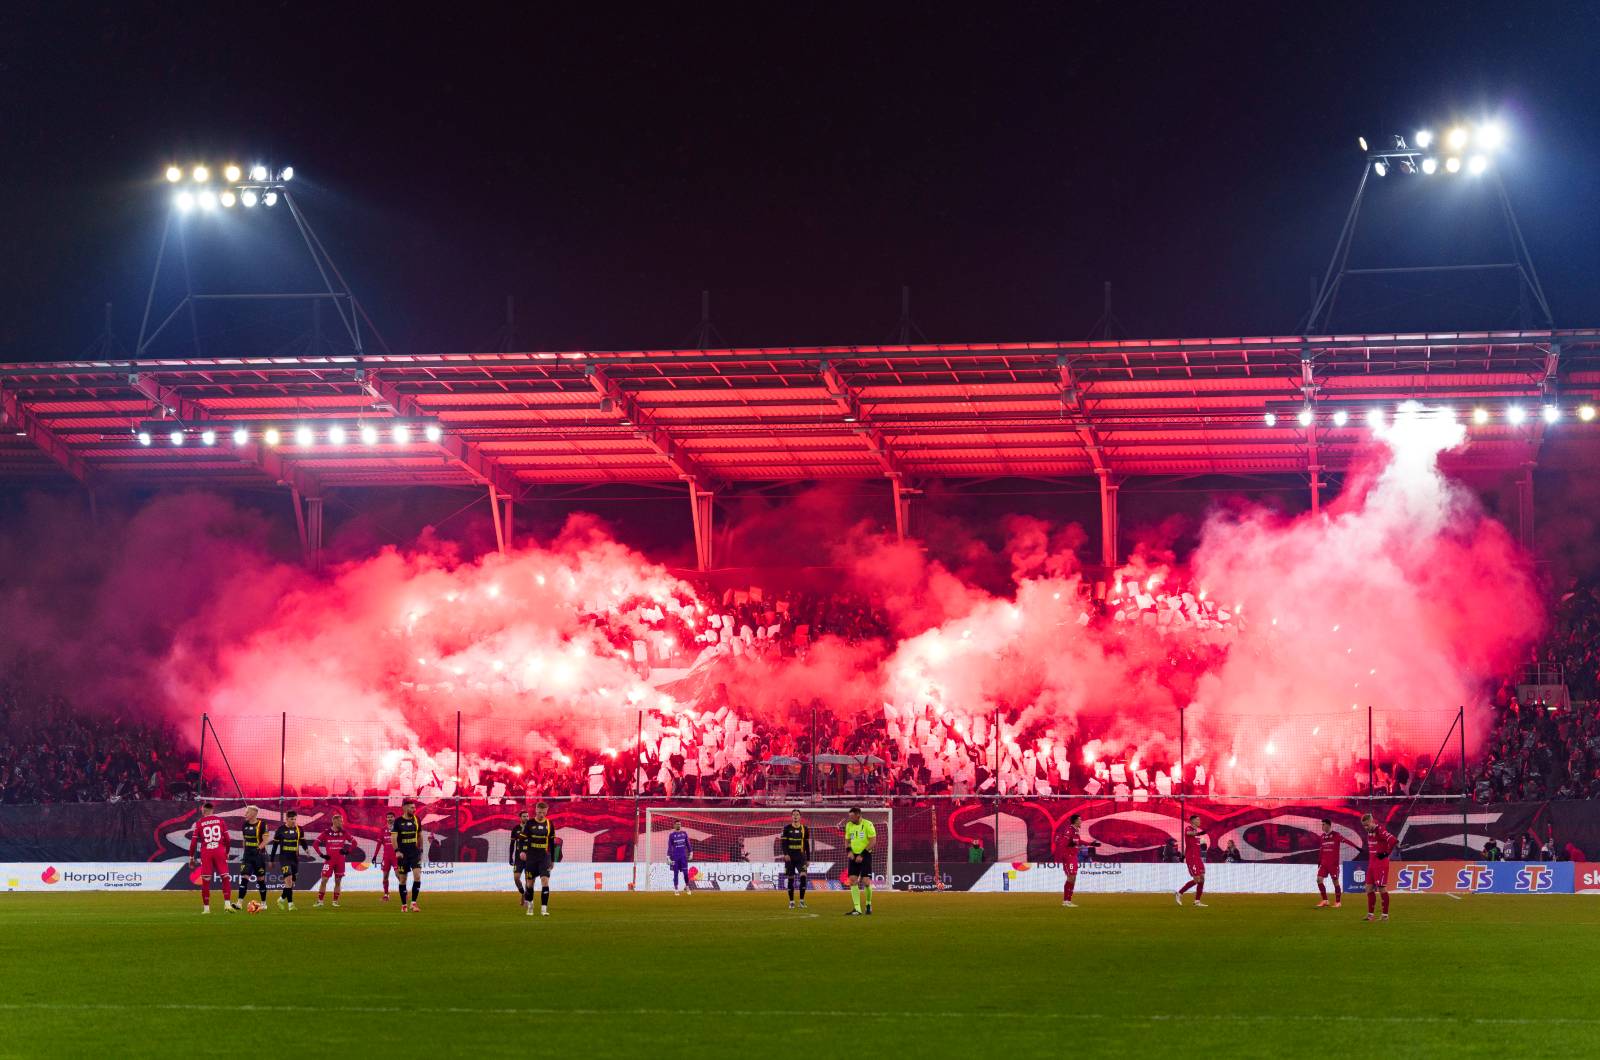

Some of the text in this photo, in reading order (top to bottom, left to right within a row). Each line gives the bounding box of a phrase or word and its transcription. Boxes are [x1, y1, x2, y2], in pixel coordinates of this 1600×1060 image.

[203, 824, 221, 843] 99
[64, 871, 142, 884] HorpolTech
[1396, 864, 1435, 891] STS
[1455, 864, 1494, 891] STS
[1514, 864, 1553, 892] STS
